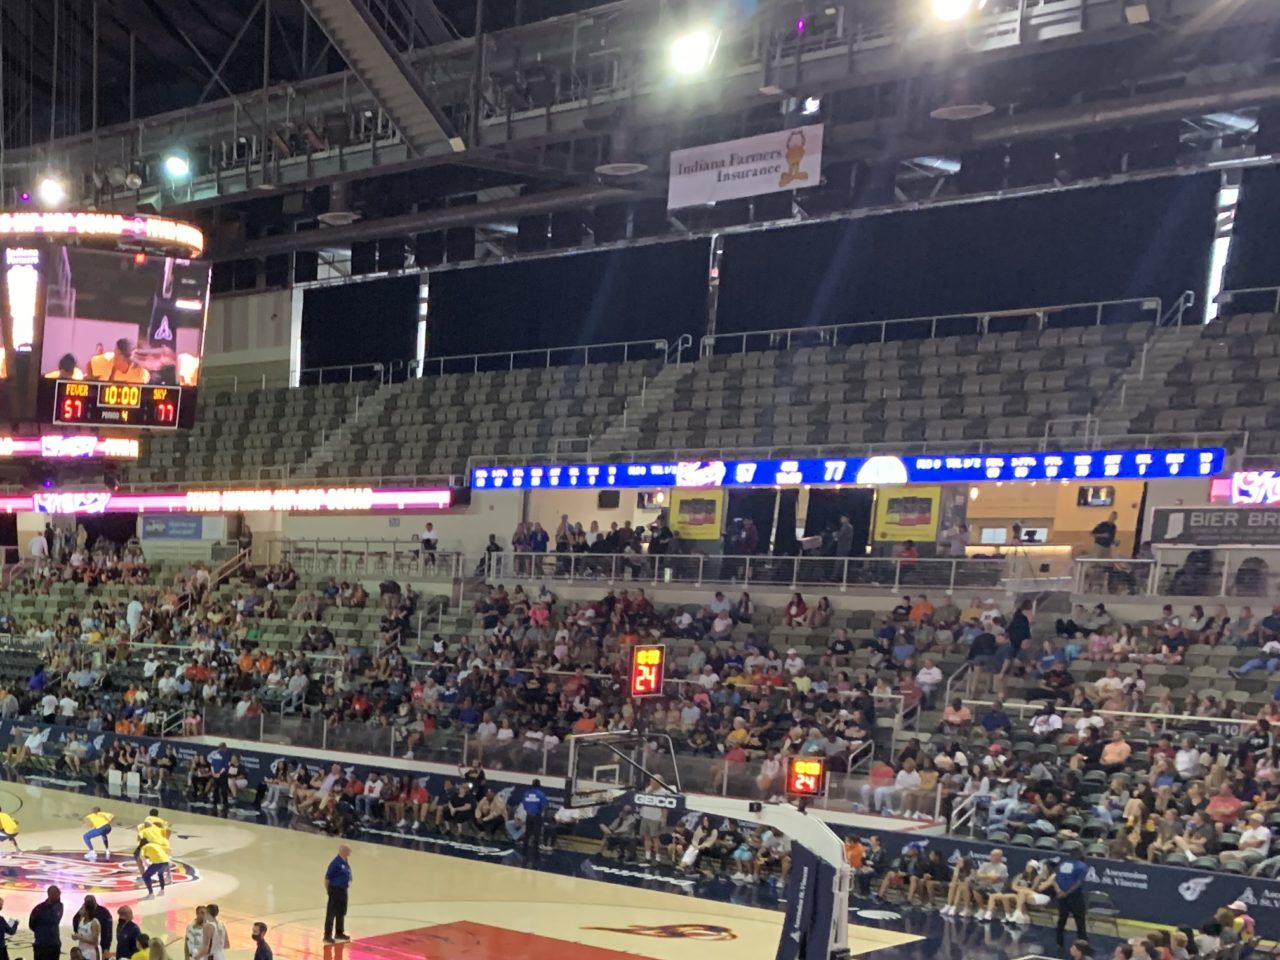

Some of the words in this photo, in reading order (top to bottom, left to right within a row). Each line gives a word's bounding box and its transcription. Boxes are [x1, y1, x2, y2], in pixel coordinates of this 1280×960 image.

[678, 158, 725, 175] Indiana
[729, 149, 783, 166] Farmers
[716, 163, 782, 182] Insurance
[66, 384, 89, 397] FEVER
[105, 386, 139, 406] 10:00
[153, 389, 167, 401] SKY
[64, 399, 82, 419] 57
[121, 409, 129, 422] 4
[158, 403, 174, 421] 77
[736, 463, 756, 483] 57
[824, 461, 846, 481] 77
[1190, 511, 1239, 526] BIER
[636, 665, 656, 690] 24
[1216, 725, 1239, 735] 110
[795, 774, 816, 790] 24
[635, 793, 677, 808] GEICO
[1104, 867, 1148, 880] Ascension
[1114, 878, 1148, 890] Vincent
